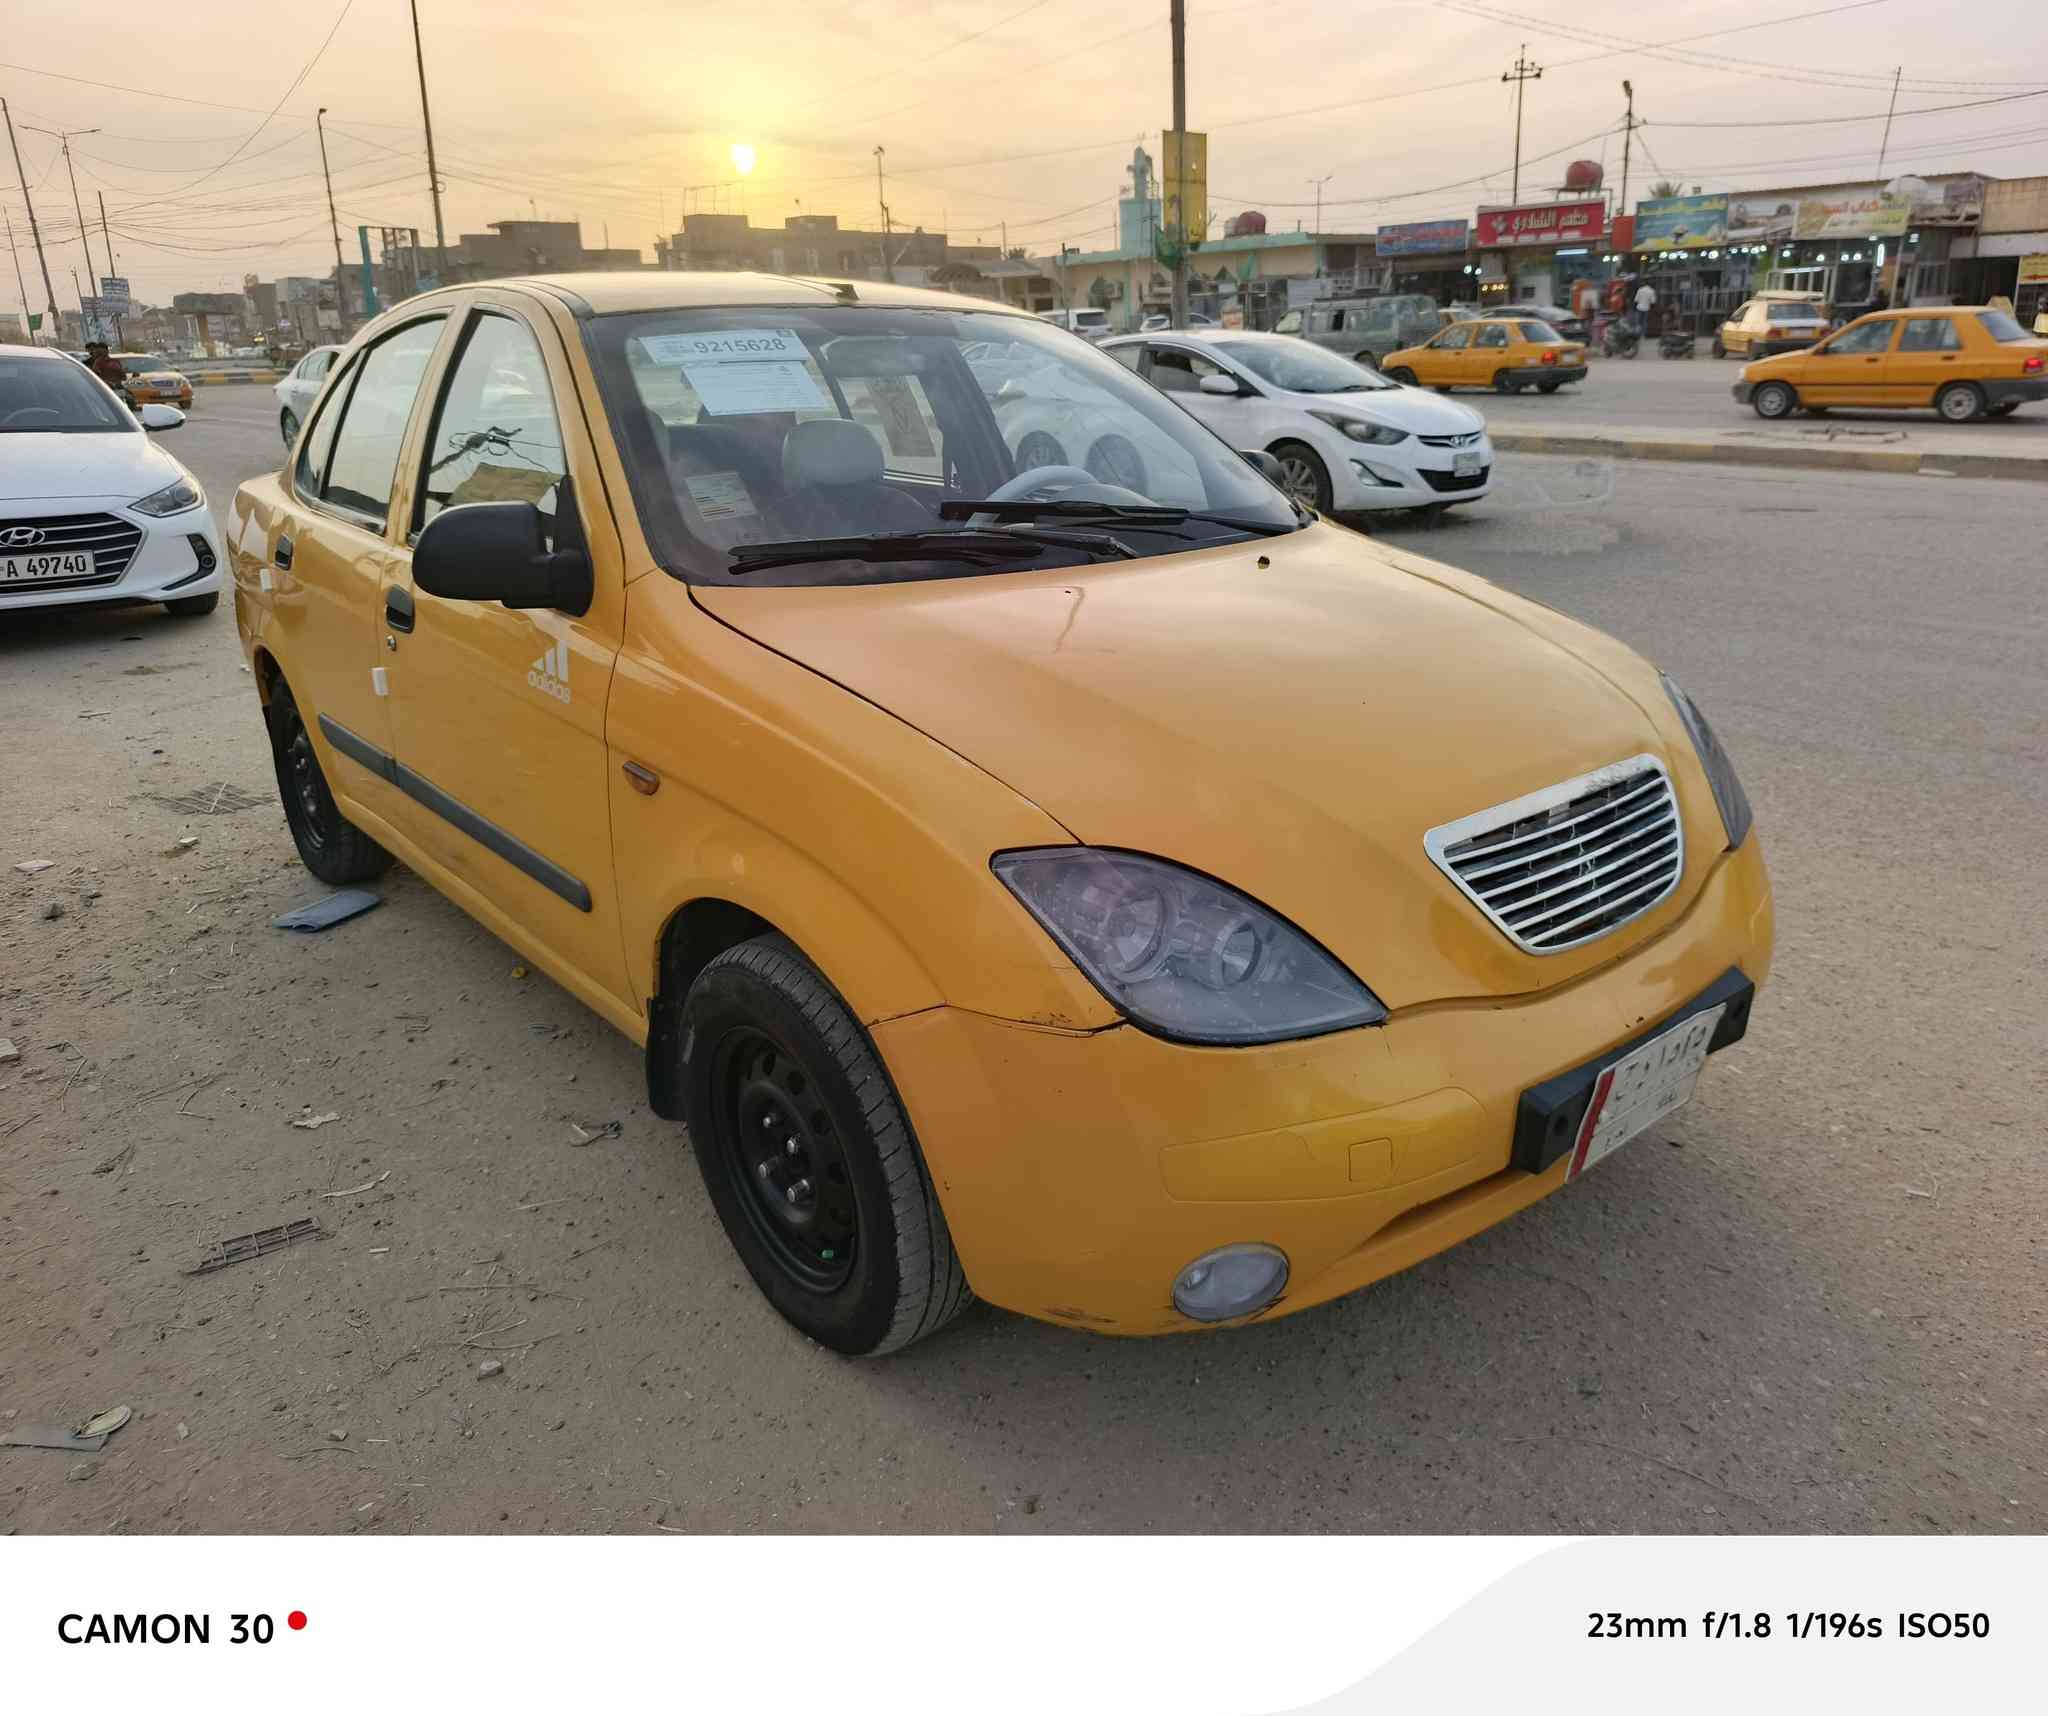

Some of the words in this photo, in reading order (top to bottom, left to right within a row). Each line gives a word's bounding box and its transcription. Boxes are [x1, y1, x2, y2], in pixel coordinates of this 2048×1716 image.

[1558, 209, 1588, 231] مطعم
[694, 338, 786, 353] 9215628
[27, 555, 87, 575] 49740
